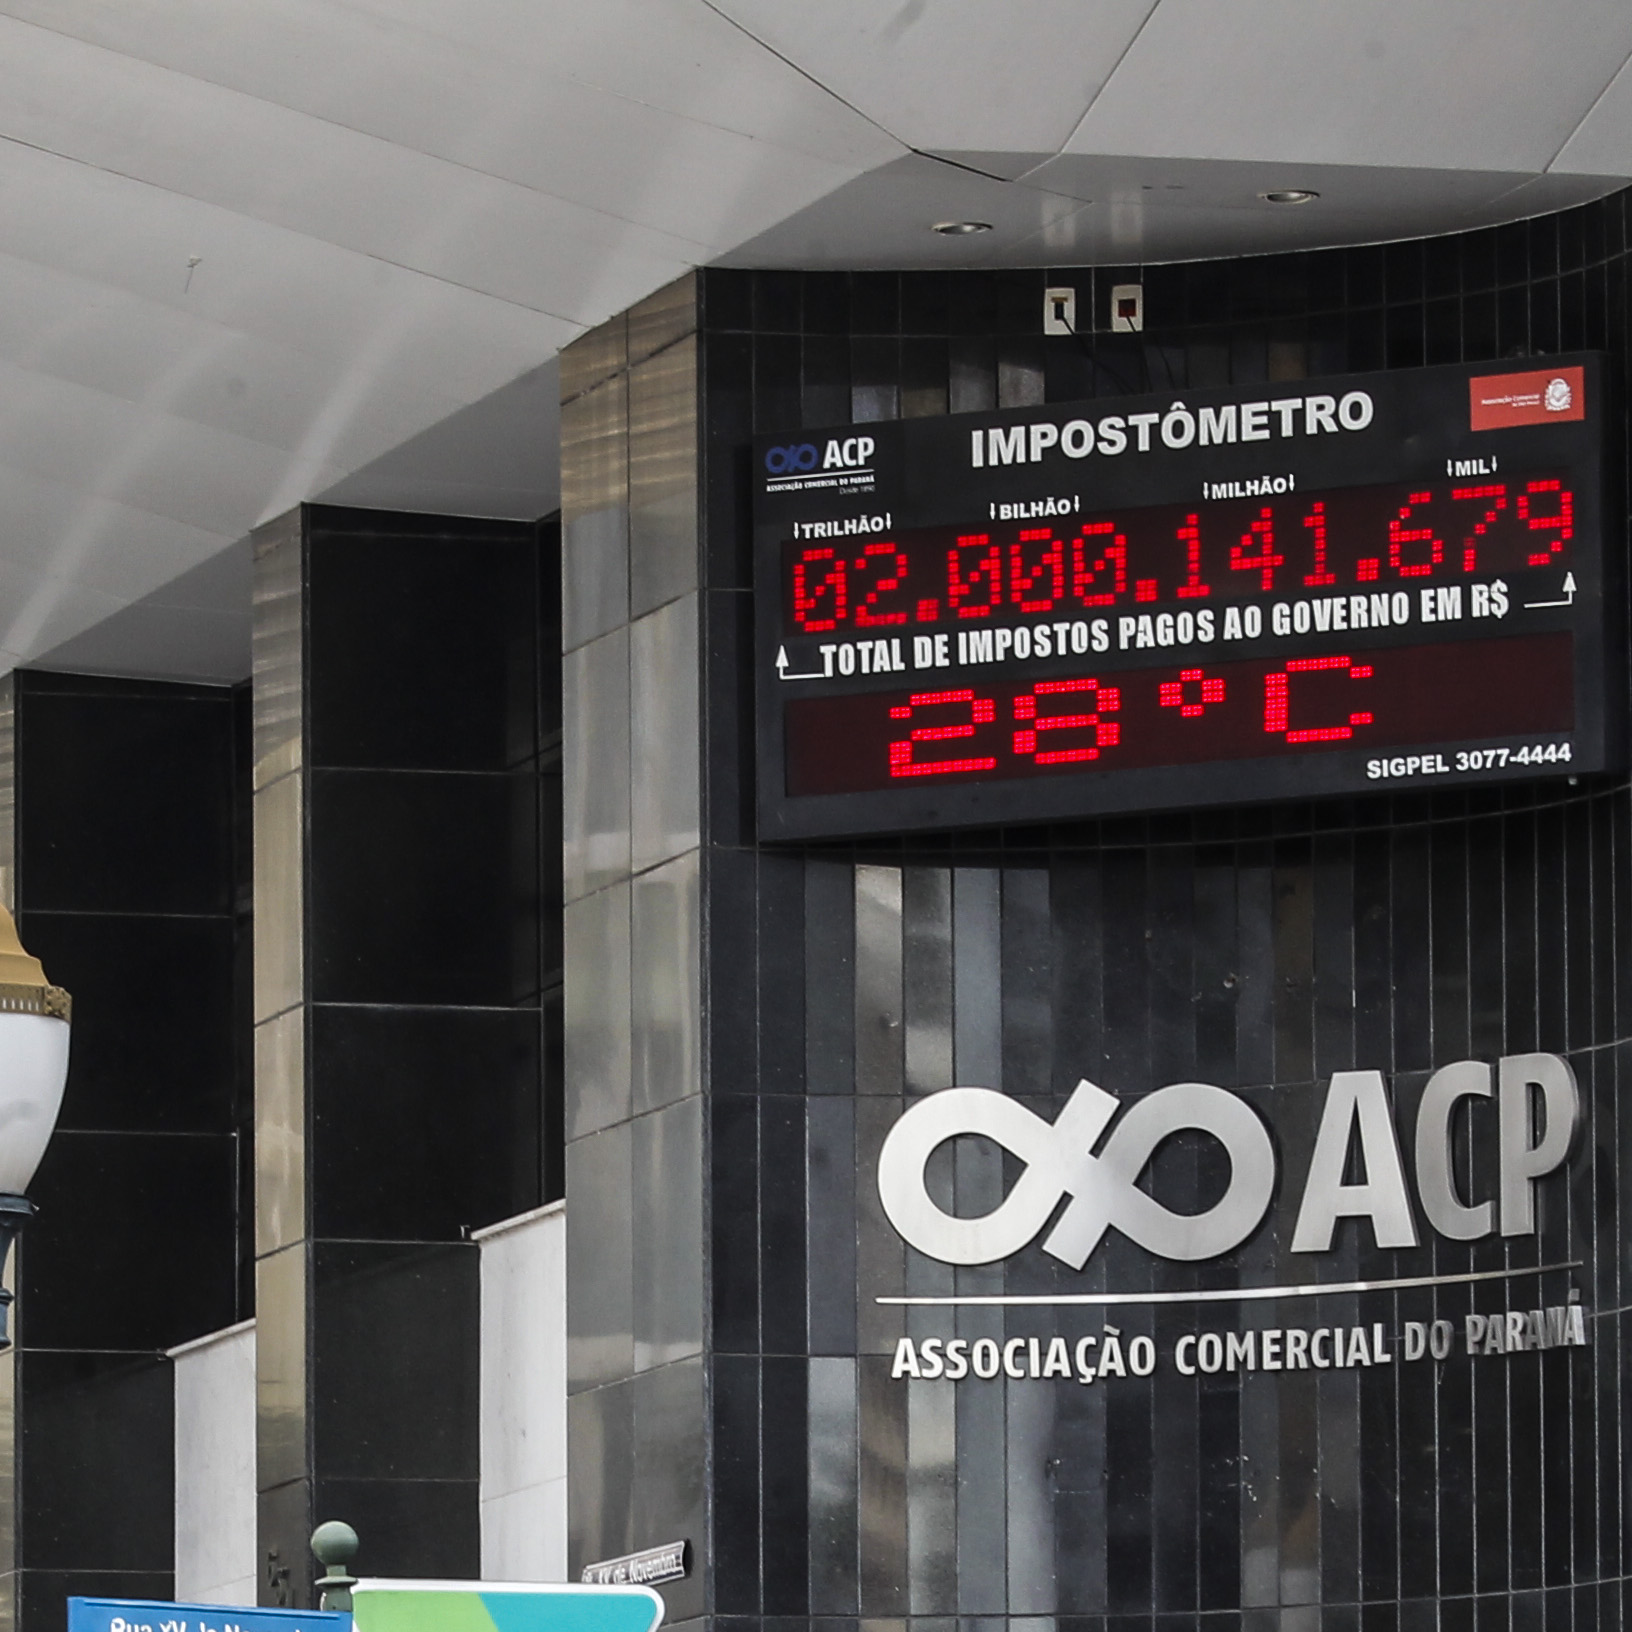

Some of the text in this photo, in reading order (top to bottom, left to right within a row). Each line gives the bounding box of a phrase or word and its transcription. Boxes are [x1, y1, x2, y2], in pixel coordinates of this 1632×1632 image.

[969, 391, 1374, 469] IMPOSTÔMETRO
[823, 437, 875, 469] ACP
[1455, 459, 1490, 477] MIL
[1211, 475, 1288, 500] MILHÃO
[801, 514, 884, 538] TRILHÃO
[999, 497, 1070, 520] BILHÃO
[793, 479, 1574, 632] 02.000.141.679
[819, 578, 1509, 678] TOTAL DE IMPOSTOS PAGOS AO GOVERNO EM R$
[1366, 741, 1572, 781] SIGPEL 3077-4444
[1290, 1052, 1580, 1254] ACP
[892, 1289, 1587, 1384] ASSOCIAÇÃO COMERCIAL DO PARANÁ
